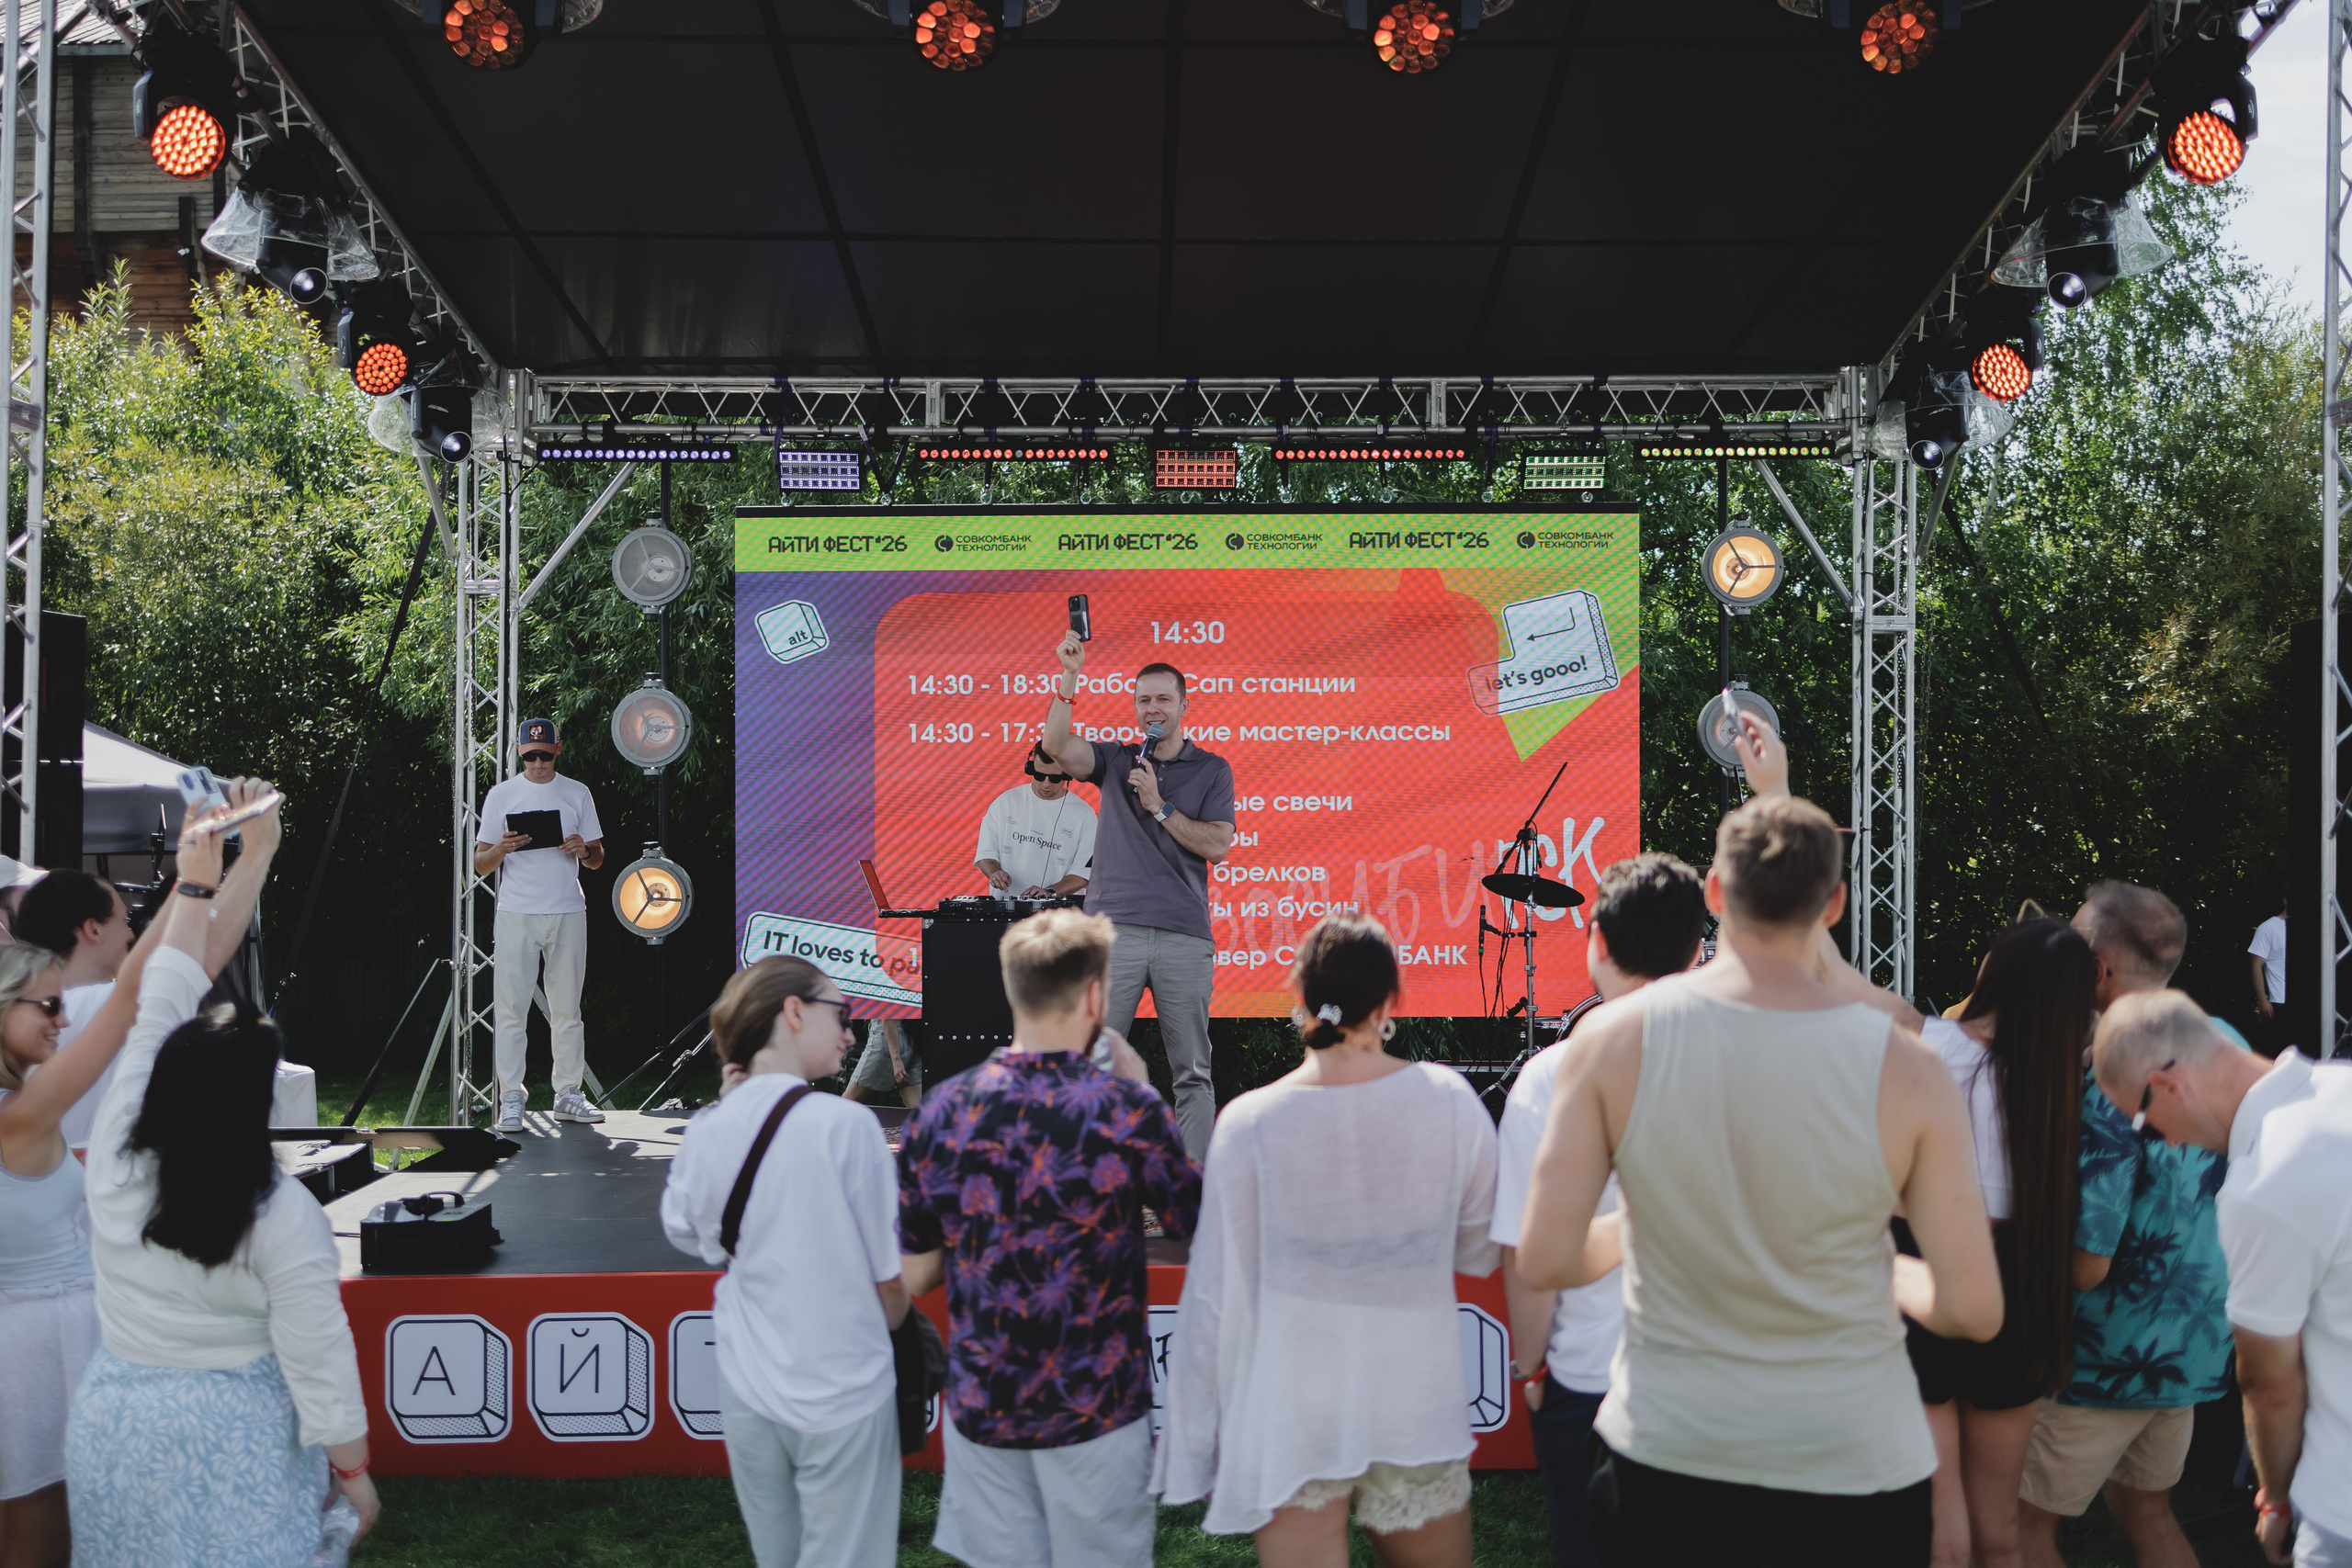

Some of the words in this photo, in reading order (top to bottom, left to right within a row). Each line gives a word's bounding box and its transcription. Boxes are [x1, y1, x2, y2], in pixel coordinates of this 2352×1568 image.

[956, 535, 1033, 544] СОВКОМБАНК
[1247, 533, 1323, 542] СОВКОМБАНК
[1537, 531, 1614, 540] СОВКОМБАНК
[1538, 540, 1609, 548] ТЕХНОЛОГИИ
[956, 544, 1027, 552] ТЕХНОЛОГИИ
[1247, 542, 1317, 550] ТЕХНОЛОГИИ
[788, 629, 808, 646] alt
[1150, 621, 1226, 644] 14:30
[908, 673, 975, 695] 14:30
[1001, 673, 1064, 694] 18:30
[1185, 672, 1234, 694] Сап
[1241, 676, 1356, 695] станции
[1485, 671, 1528, 693] let's
[1531, 655, 1589, 686] gooo!
[908, 722, 975, 743] 14:30
[1001, 722, 1047, 743] 17:3
[1239, 722, 1451, 746] мастер-классы
[1272, 795, 1353, 812] свечи
[1012, 830, 1035, 844] Open
[1035, 837, 1062, 851] Space
[1213, 861, 1327, 886] брелков
[1240, 901, 1270, 918] из
[1277, 896, 1359, 921] бусин
[763, 931, 790, 952] IT
[791, 935, 854, 964] loves
[860, 948, 885, 969] to
